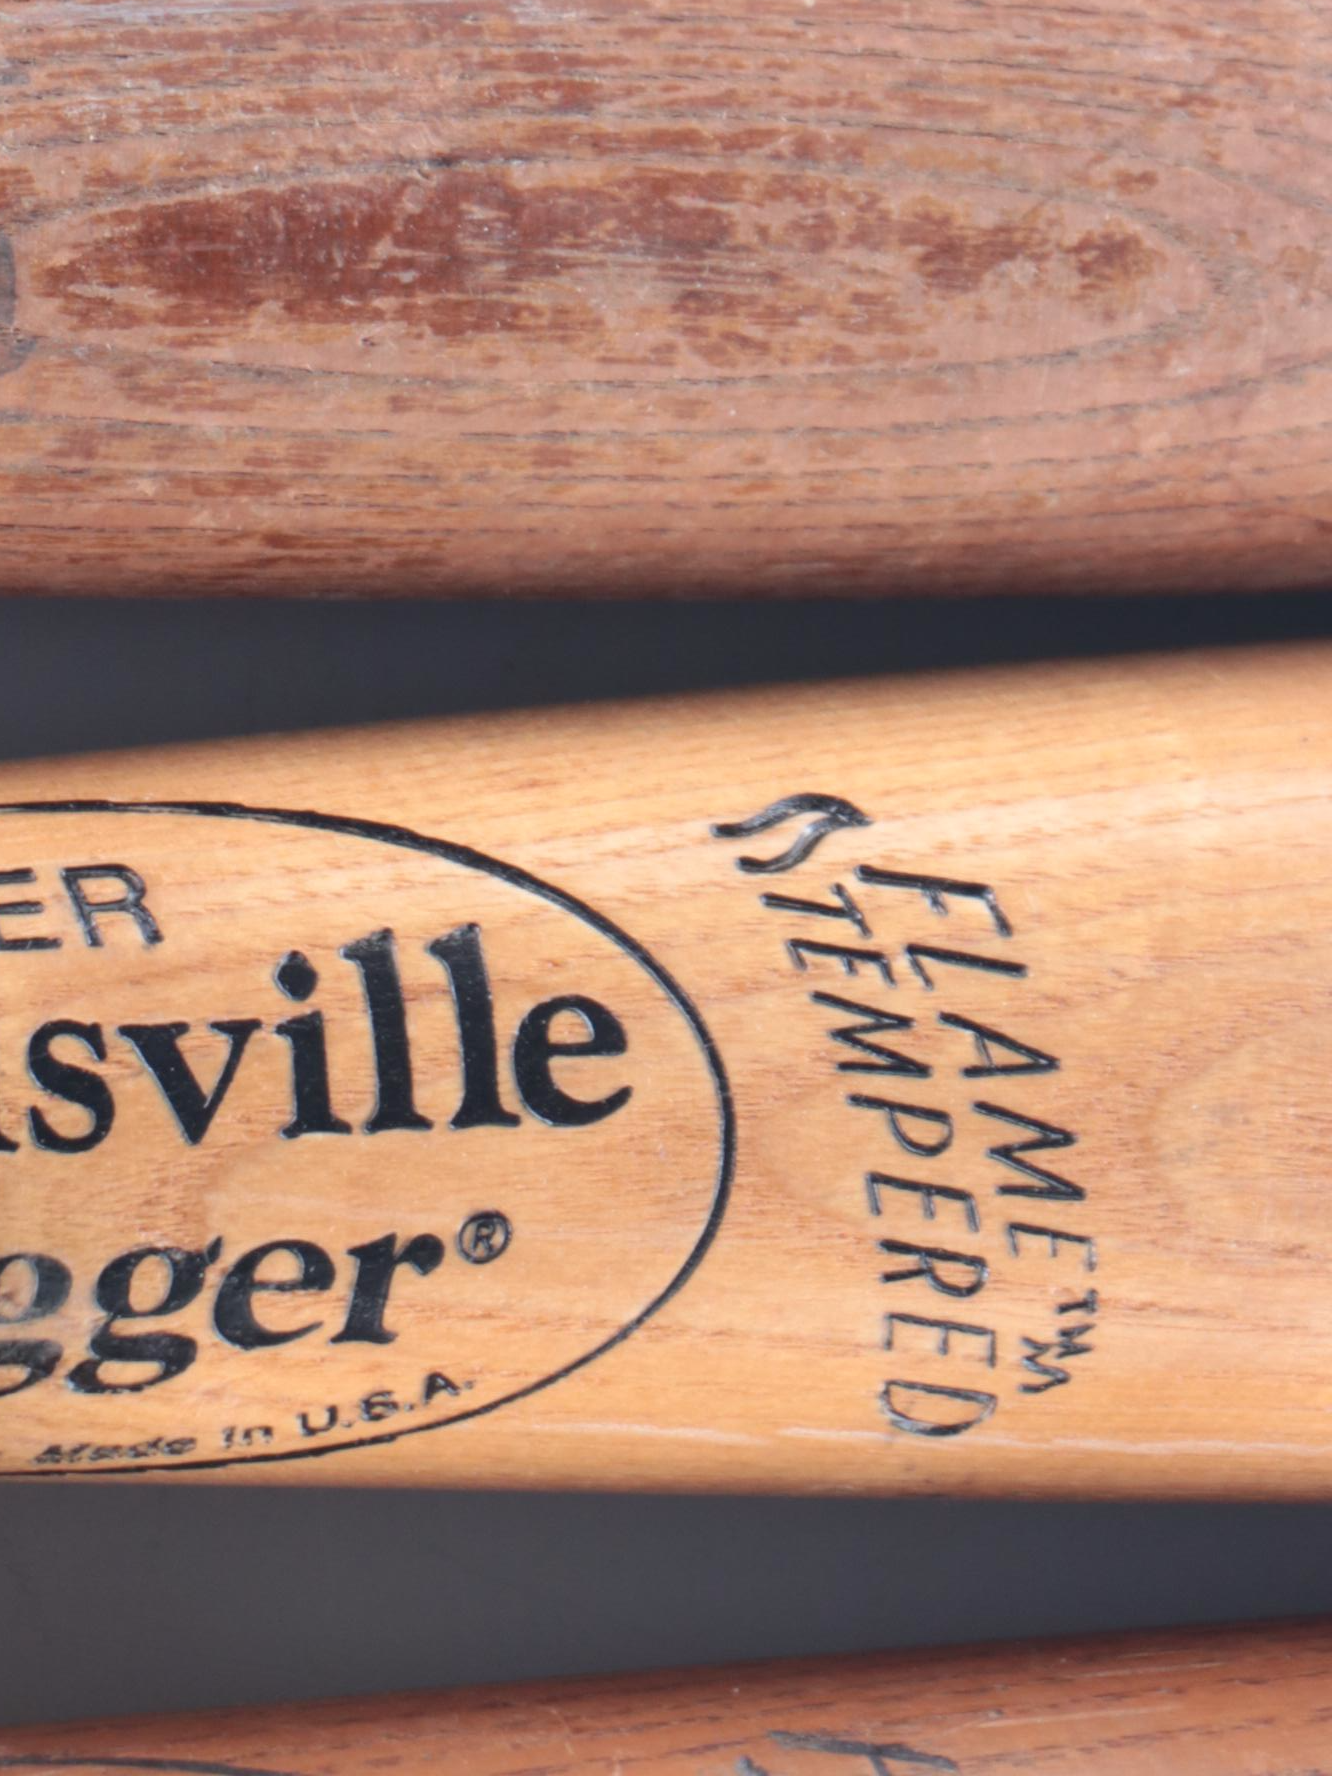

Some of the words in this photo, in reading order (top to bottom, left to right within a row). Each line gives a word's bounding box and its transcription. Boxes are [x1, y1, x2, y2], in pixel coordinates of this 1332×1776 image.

[761, 882, 1000, 1437] TEMPERED
[854, 864, 1098, 1272] FLAME
[34, 1435, 197, 1465] Made
[222, 1422, 274, 1451] in
